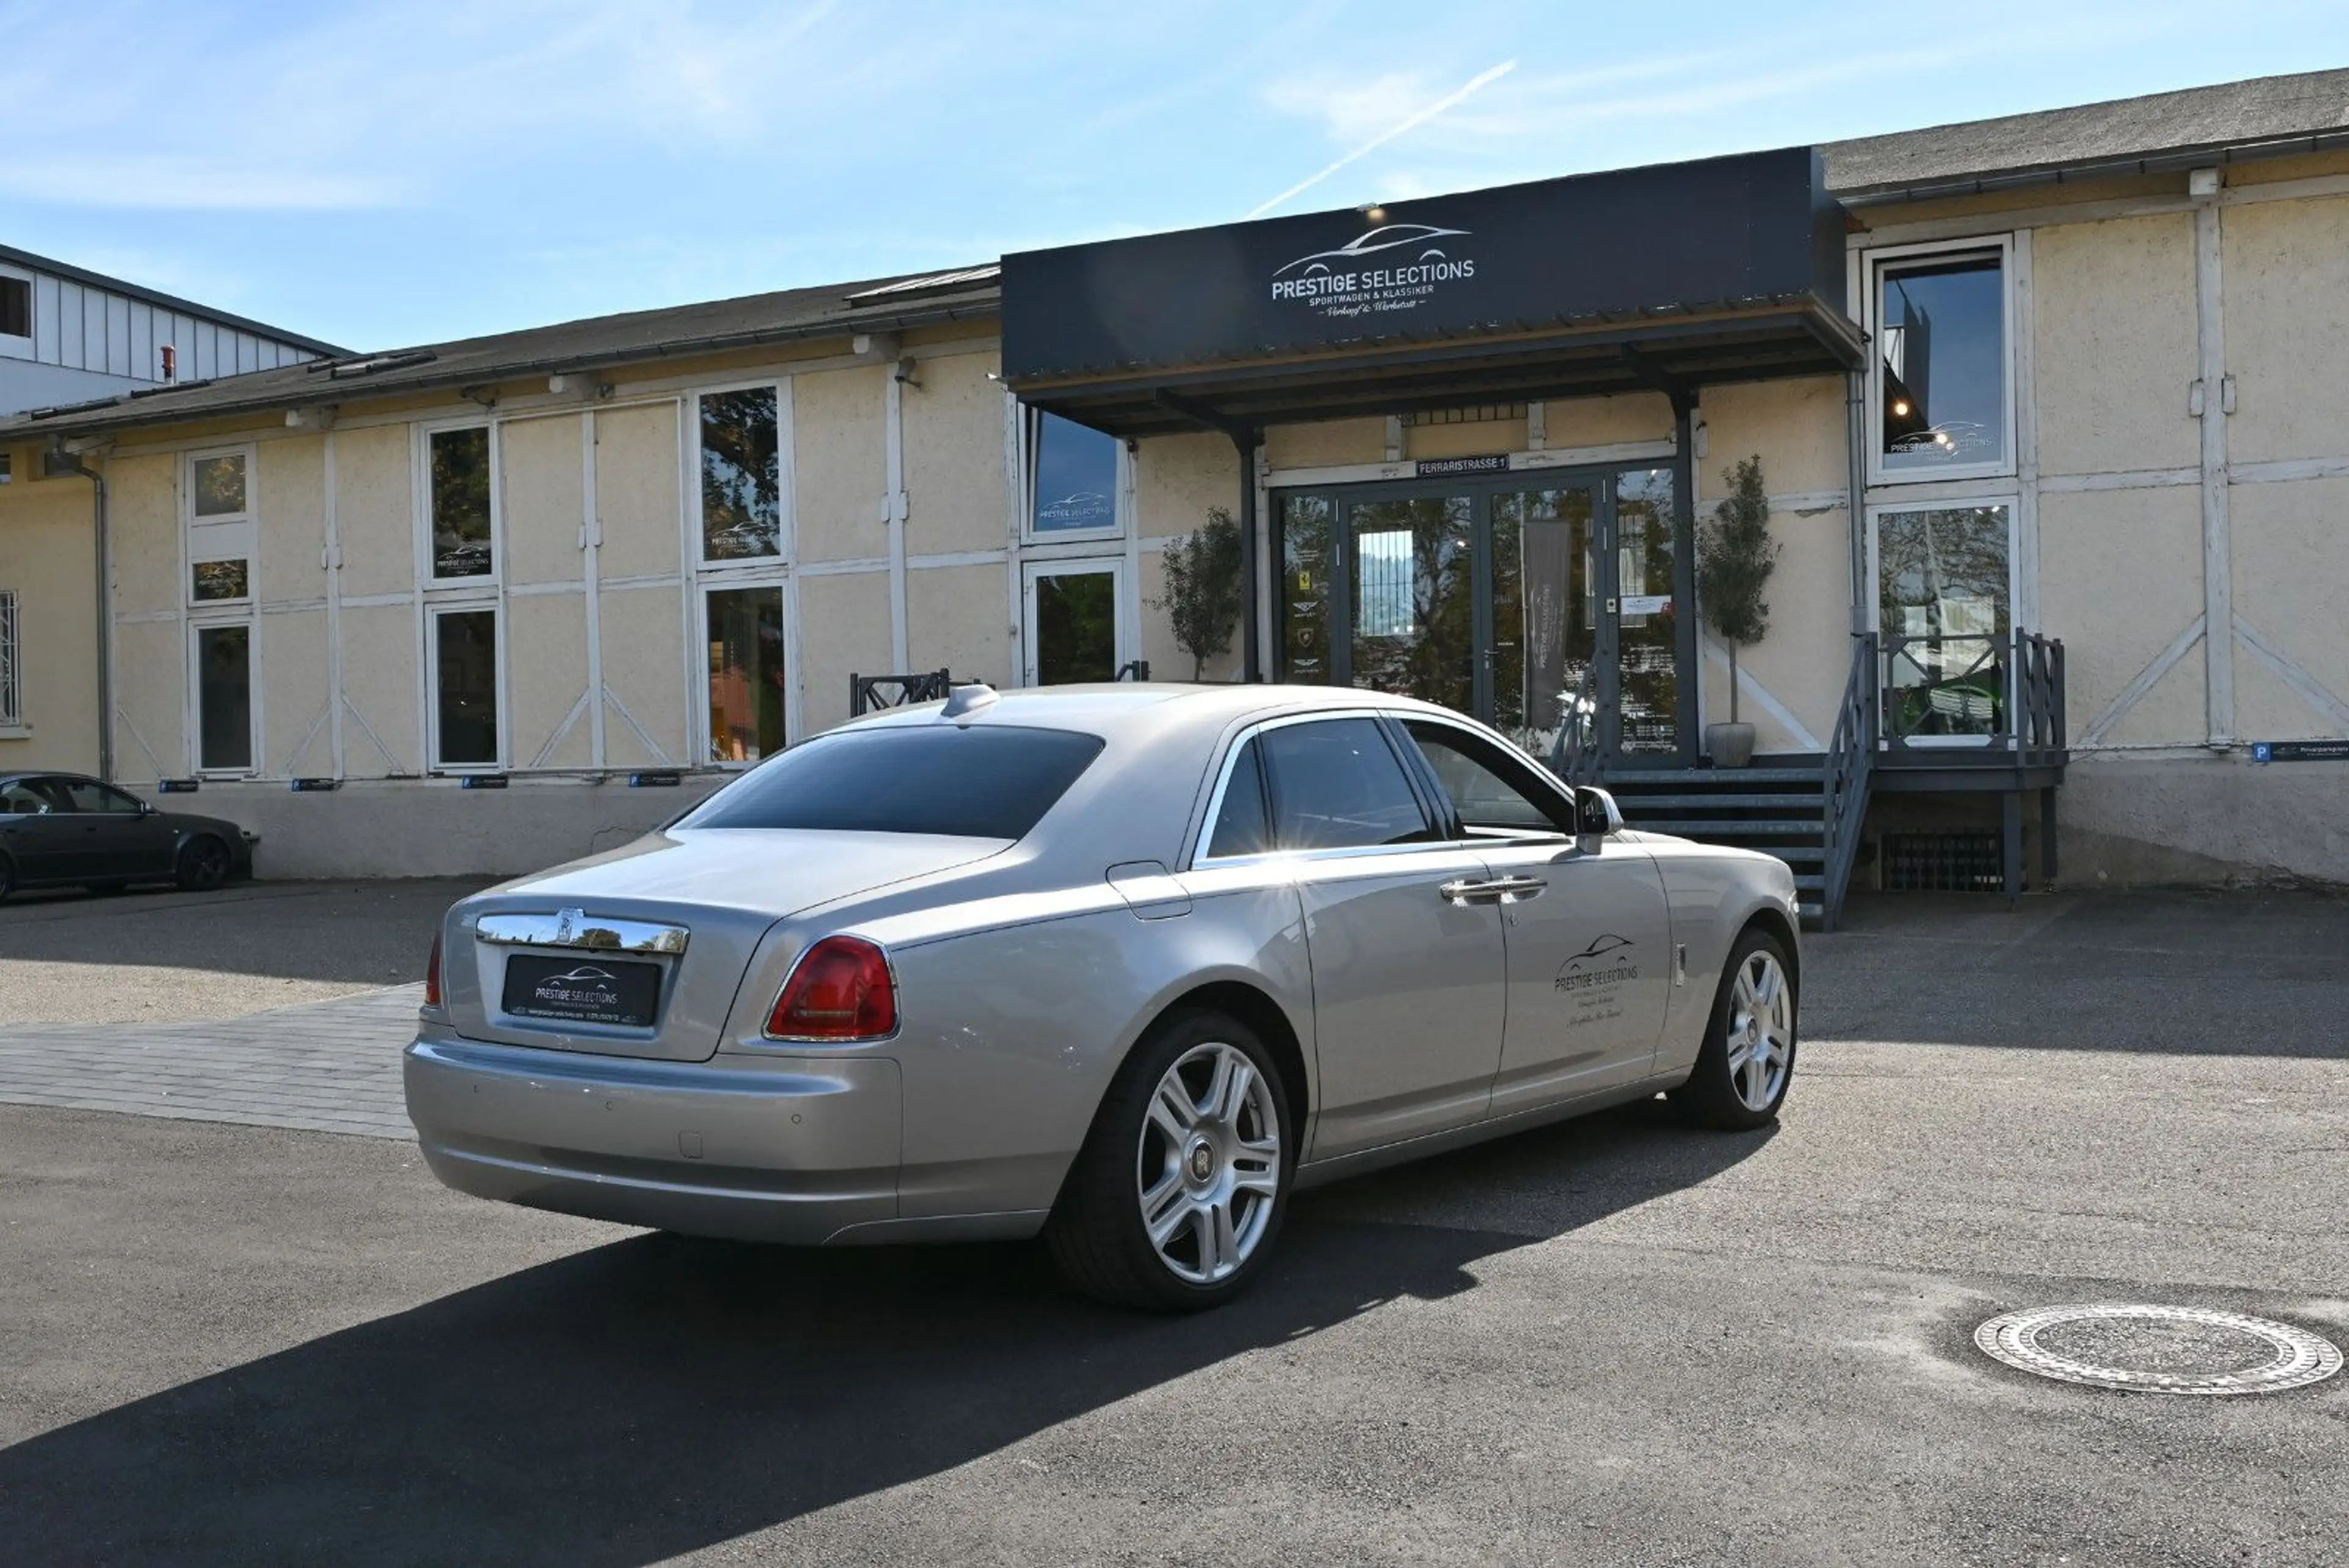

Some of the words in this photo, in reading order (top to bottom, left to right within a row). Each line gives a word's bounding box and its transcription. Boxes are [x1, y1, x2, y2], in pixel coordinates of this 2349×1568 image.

[1272, 273, 1357, 300] PRESTIGE
[1362, 260, 1474, 289] SELECTIONS
[1309, 292, 1370, 306] SPORTWAGEN
[1382, 284, 1434, 298] KLASSIKER
[1419, 458, 1497, 474] FERRARISTRASSE
[2257, 747, 2266, 759] P
[1554, 973, 1592, 992] PRESTIGE
[1594, 965, 1638, 986] SELECTIONS
[535, 987, 571, 1001] PRESTIGE
[572, 990, 617, 1004] SELECTIONS
